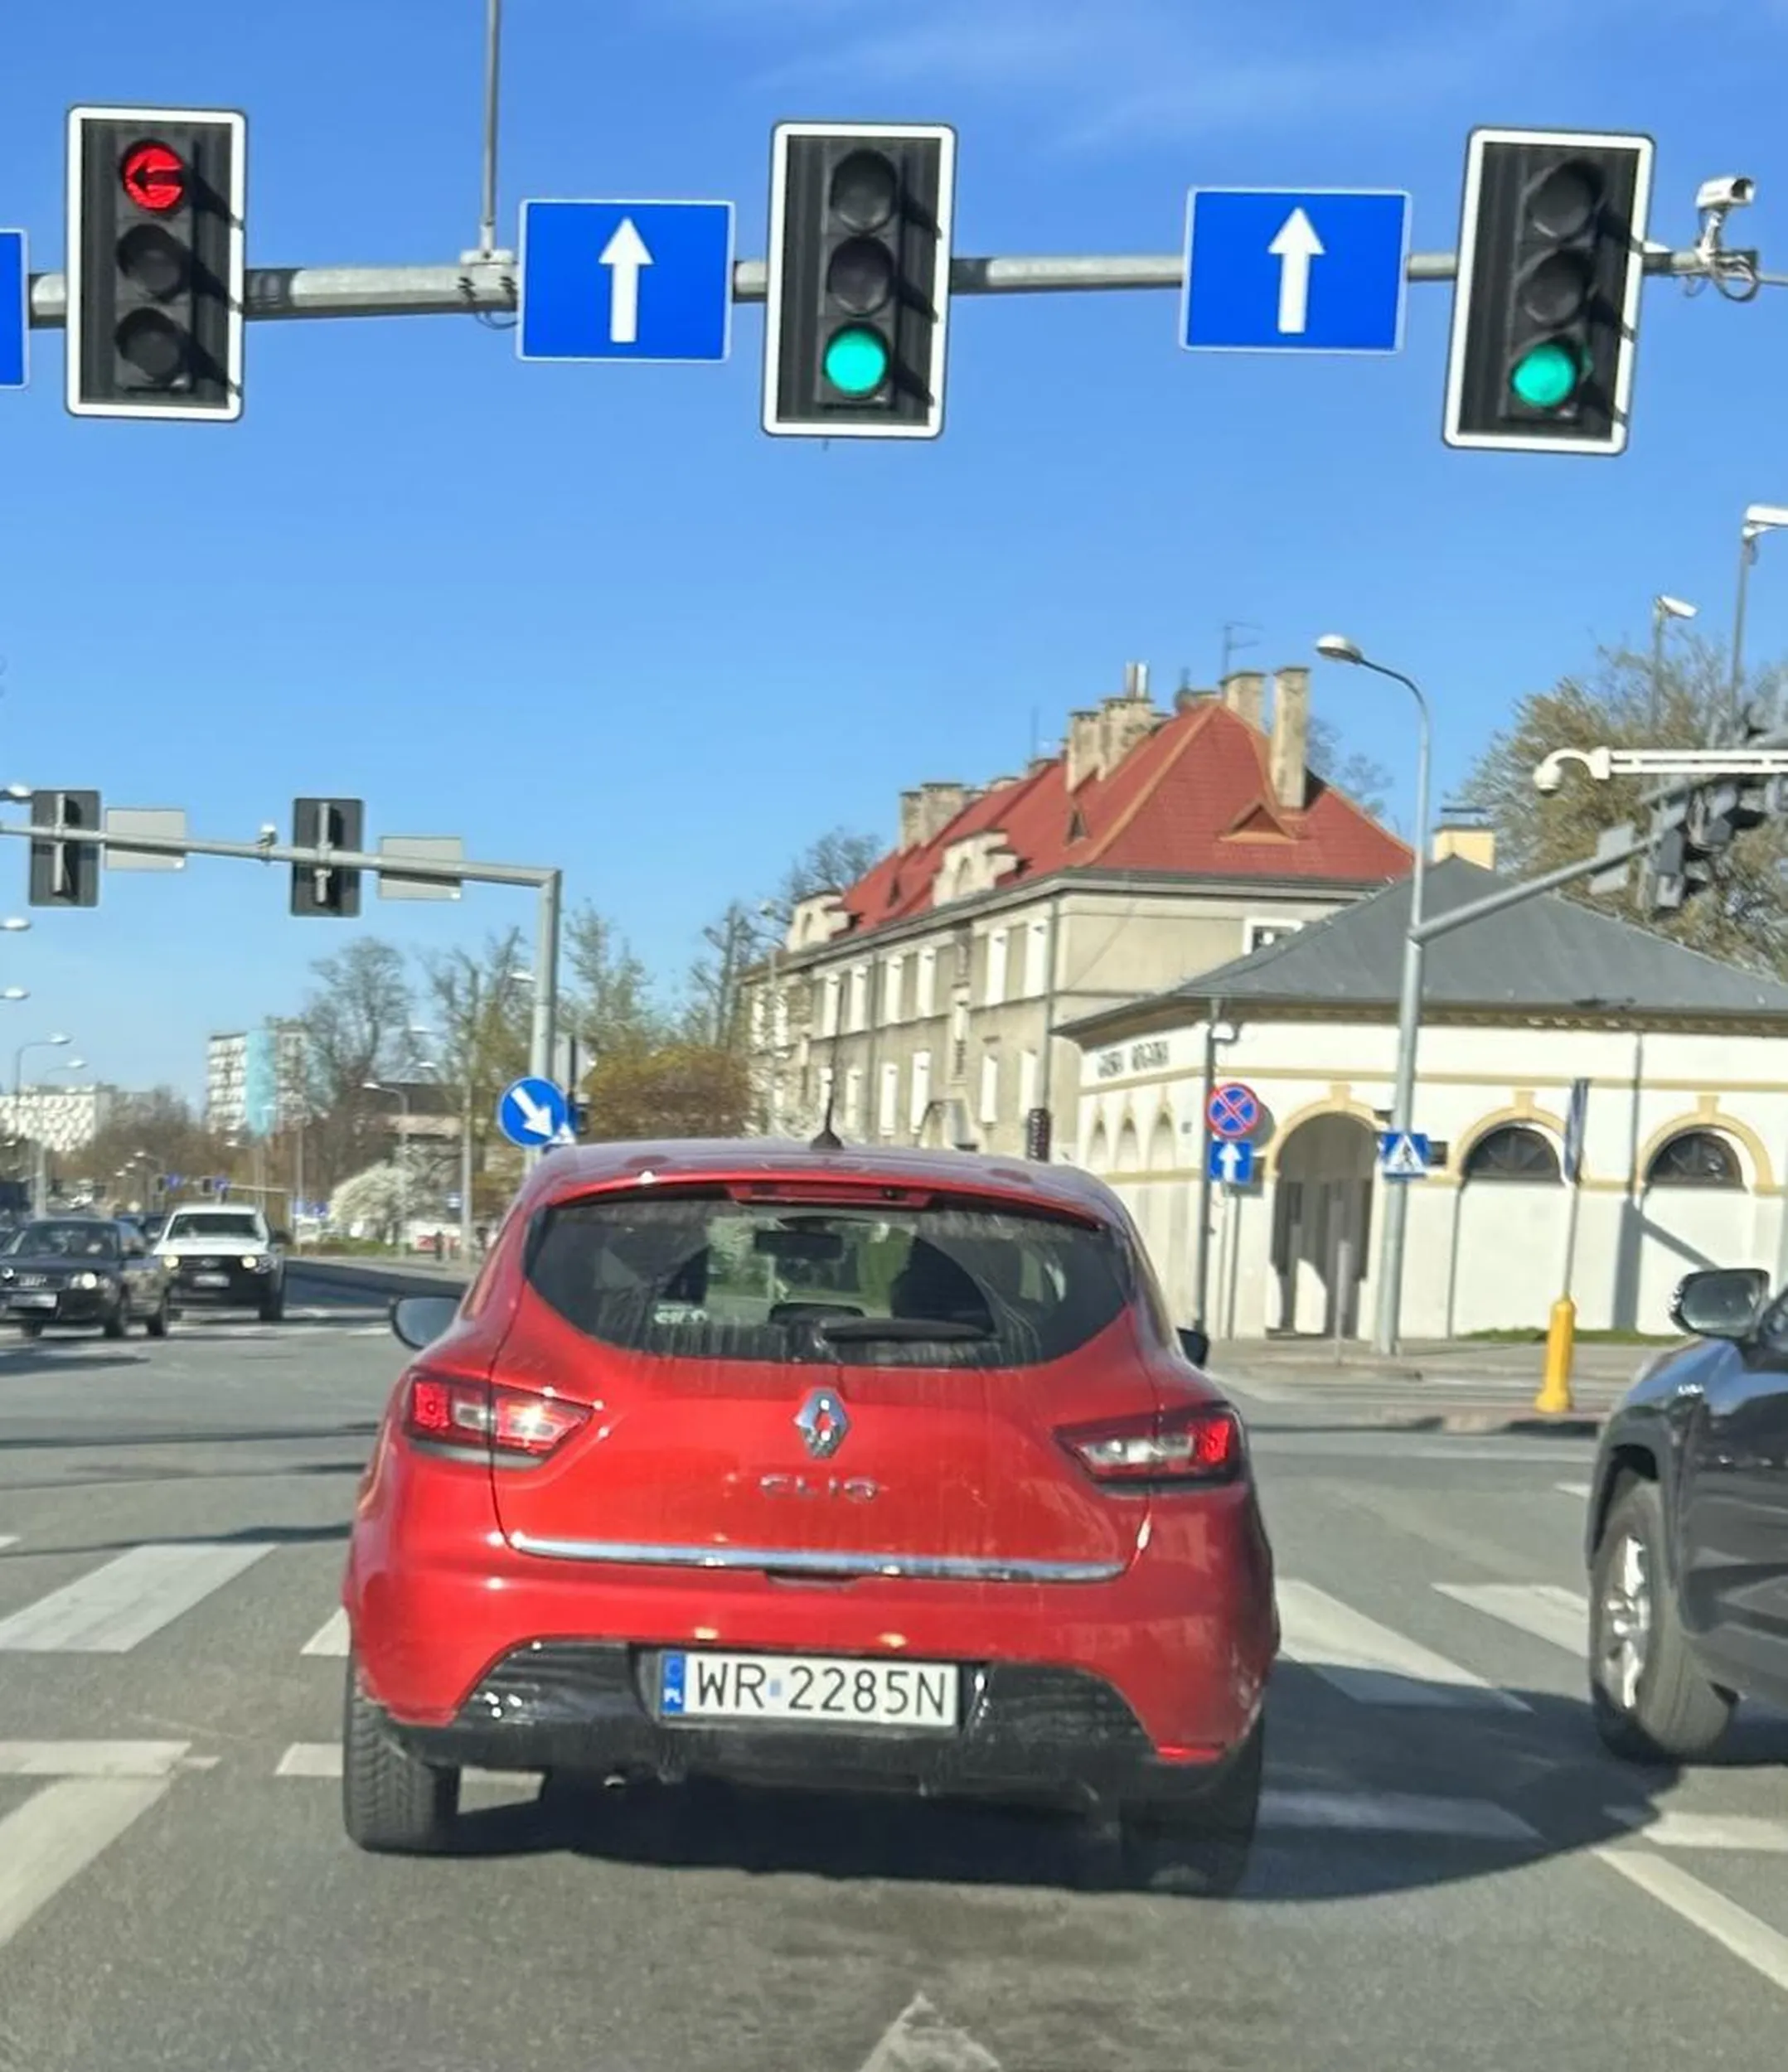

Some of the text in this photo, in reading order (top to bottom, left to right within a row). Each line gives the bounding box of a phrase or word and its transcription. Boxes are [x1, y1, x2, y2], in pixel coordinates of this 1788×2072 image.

[760, 1474, 877, 1504] CLIO
[697, 1661, 946, 1718] WR 2285N
